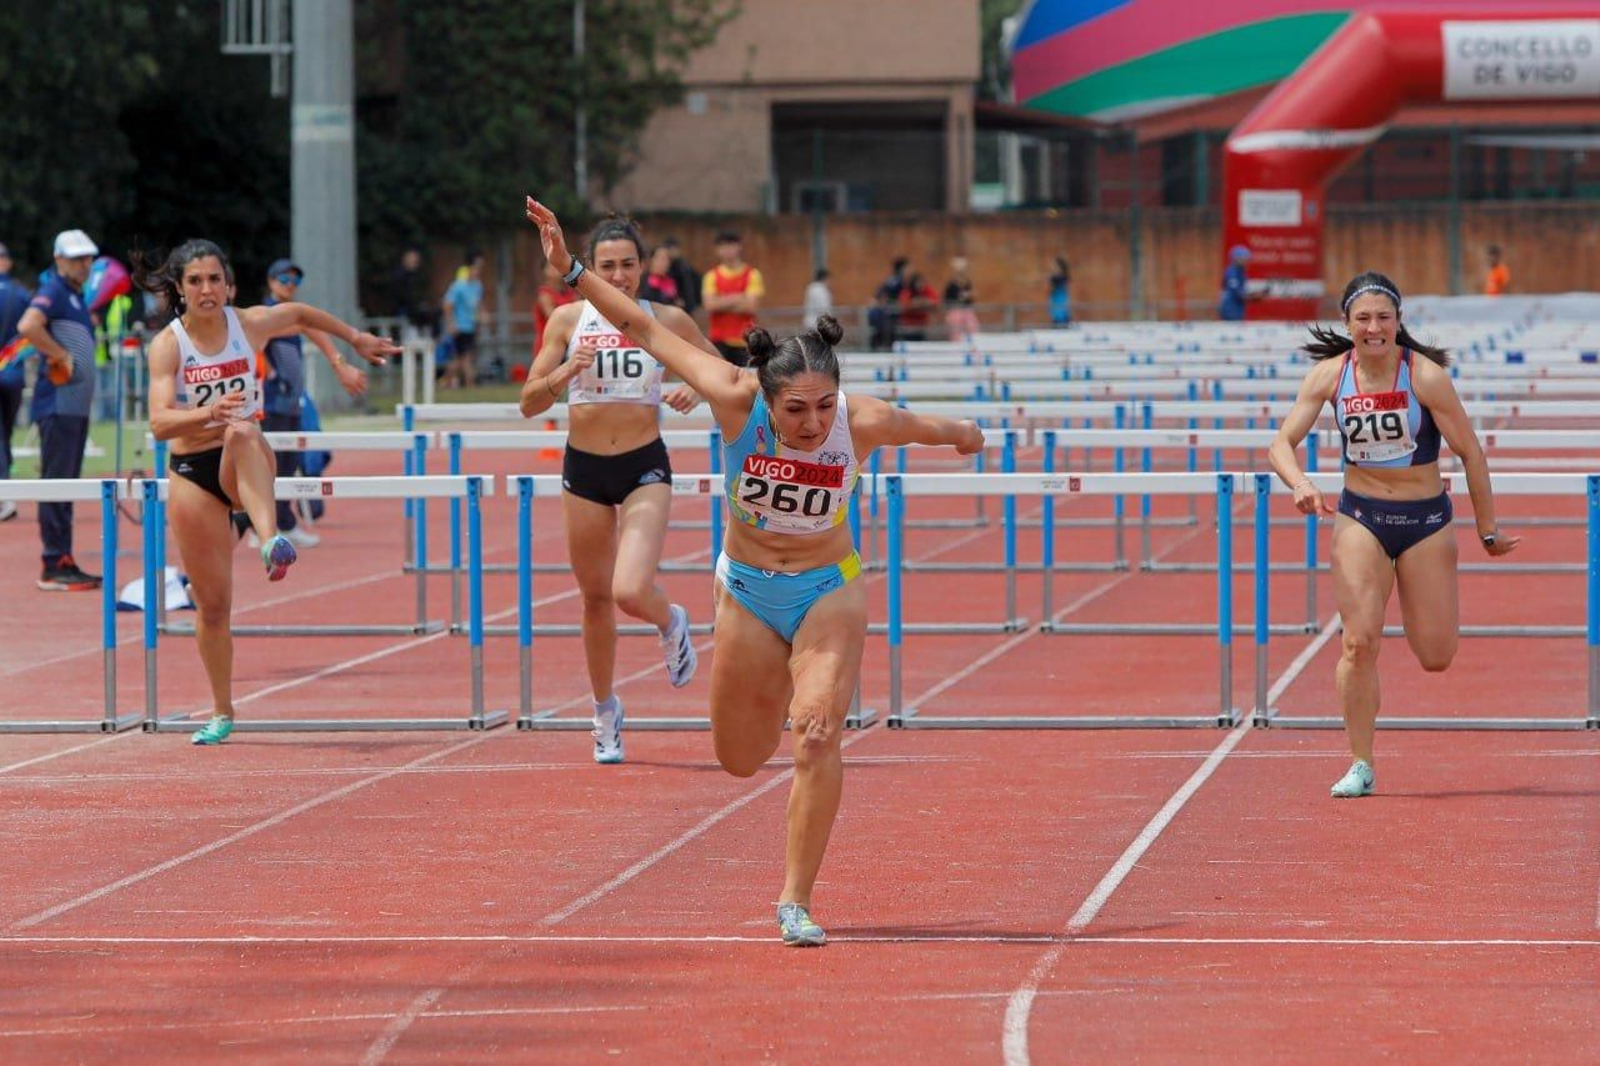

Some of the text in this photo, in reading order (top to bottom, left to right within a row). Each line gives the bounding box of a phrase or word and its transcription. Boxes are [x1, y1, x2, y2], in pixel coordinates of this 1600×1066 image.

[1457, 35, 1593, 59] CONCELLO
[1473, 61, 1578, 85] DE VIGO
[596, 349, 643, 379] 116
[1344, 412, 1404, 444] 219
[742, 477, 832, 517] 260
